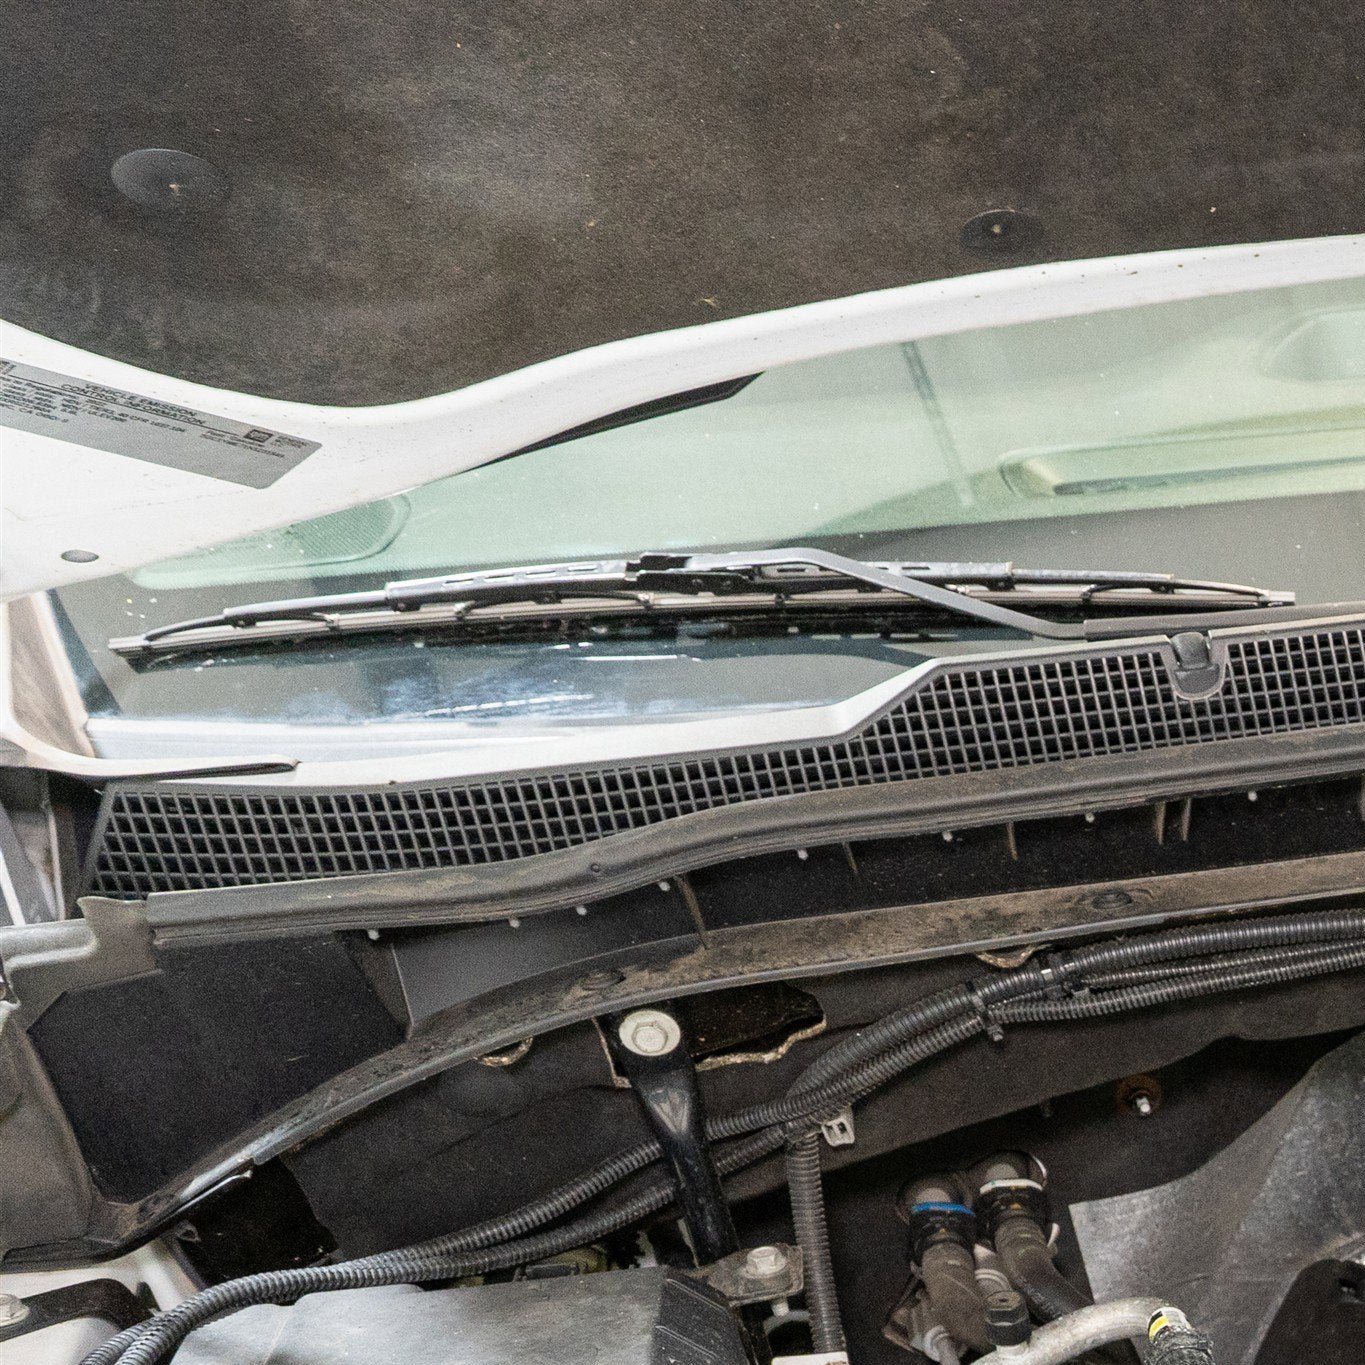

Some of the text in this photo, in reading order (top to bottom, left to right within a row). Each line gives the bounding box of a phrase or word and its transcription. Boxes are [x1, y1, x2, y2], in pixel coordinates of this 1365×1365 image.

[59, 383, 119, 401] CONTROL
[122, 400, 206, 424] INFORMATION
[83, 384, 198, 416] VEHICLE EMISSION
